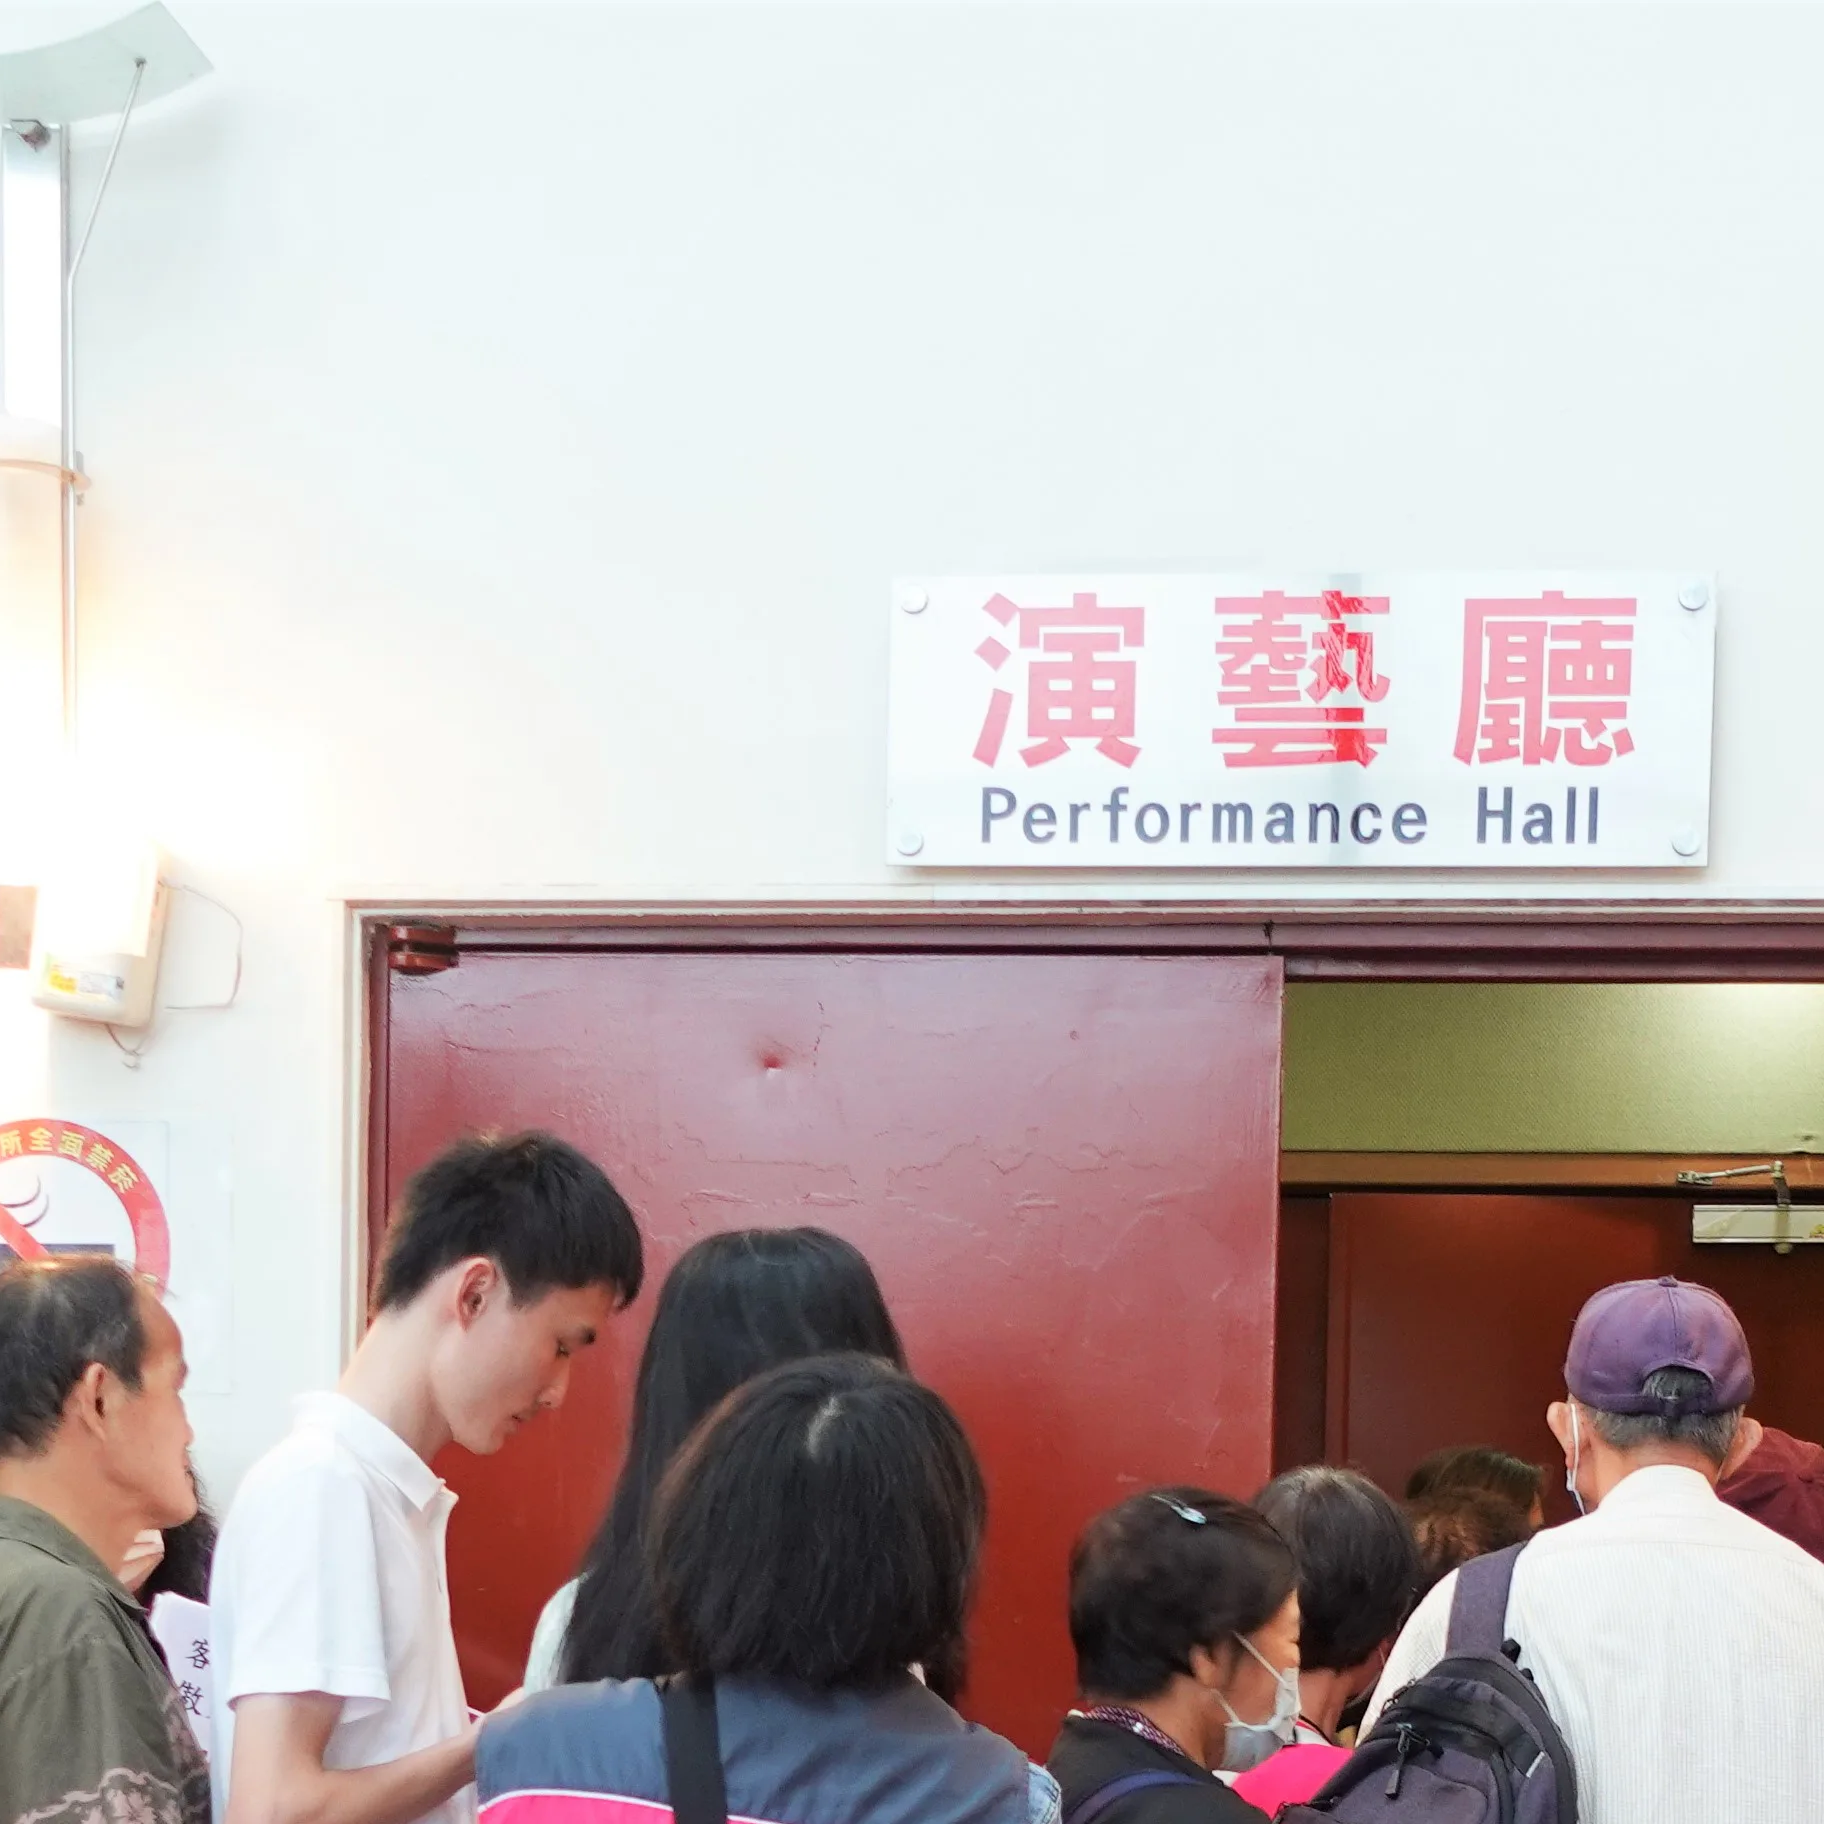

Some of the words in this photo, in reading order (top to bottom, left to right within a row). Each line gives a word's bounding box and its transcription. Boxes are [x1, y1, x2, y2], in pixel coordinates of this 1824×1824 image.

[972, 590, 1637, 768] 演藝廳
[981, 786, 1429, 846] Performance
[1477, 786, 1600, 845] Hall
